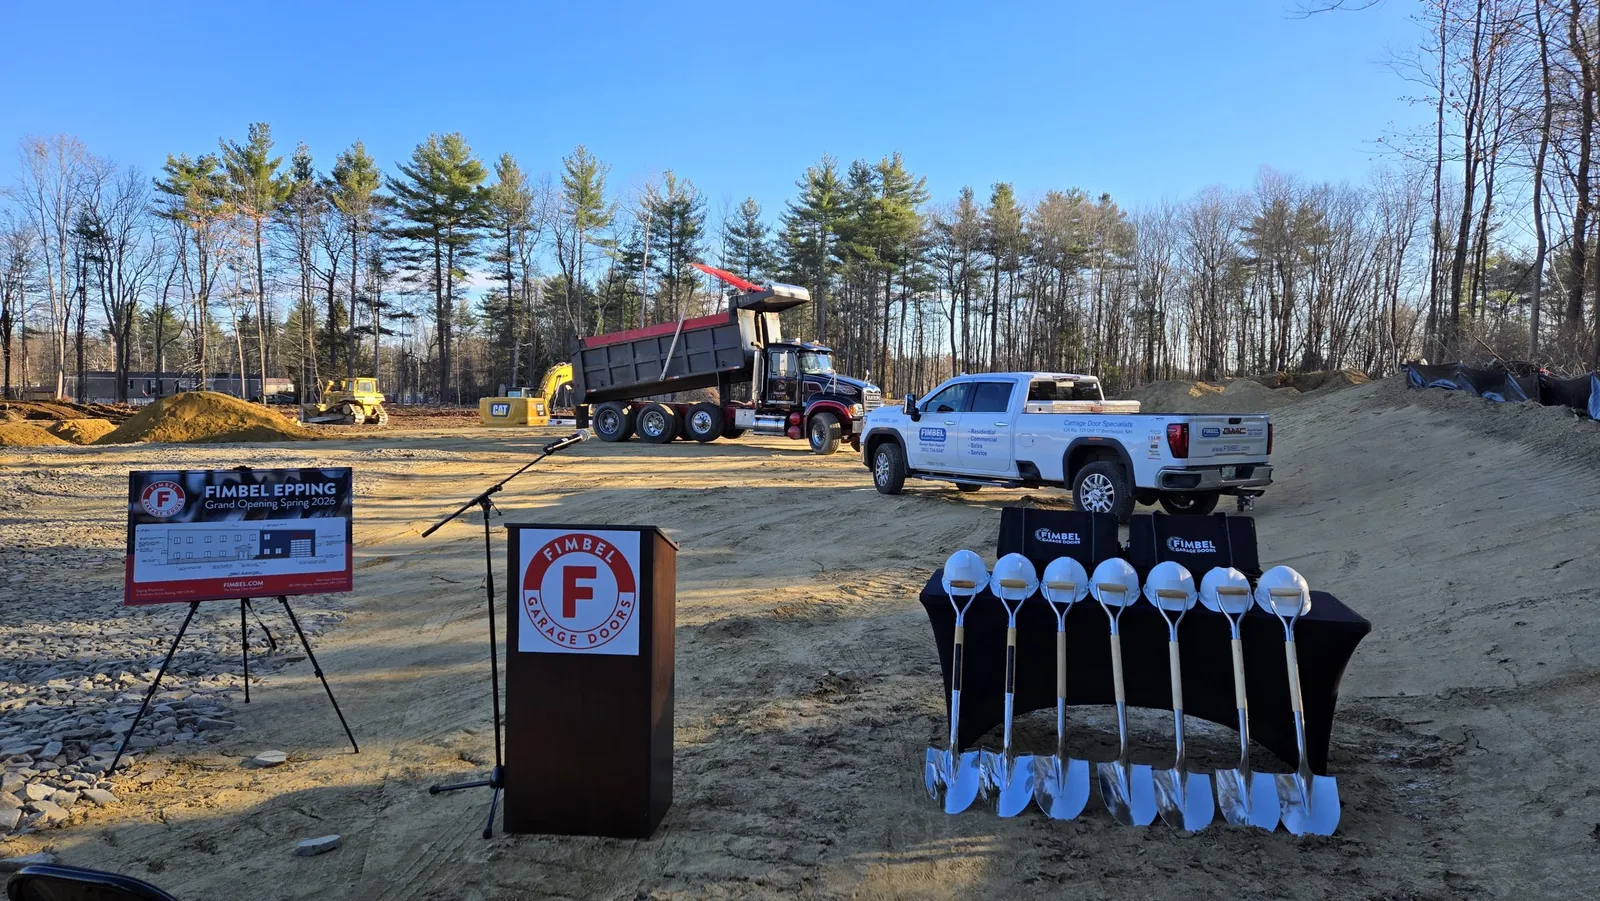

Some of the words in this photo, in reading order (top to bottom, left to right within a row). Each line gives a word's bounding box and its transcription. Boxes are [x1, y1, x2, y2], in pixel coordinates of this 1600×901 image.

[492, 403, 508, 416] CAT
[205, 484, 269, 498] FIMBEL
[274, 483, 336, 496] EPPING
[157, 491, 170, 507] F
[205, 499, 234, 509] Grand
[238, 498, 278, 510] Opening
[280, 498, 309, 510] Spring
[311, 497, 336, 506] 2026
[1041, 531, 1080, 540] FIMBEL
[542, 537, 616, 564] FIMBEL
[1174, 540, 1216, 549] FIMBEL
[562, 565, 597, 618] F
[528, 596, 577, 645] GARAGE
[588, 599, 631, 644] DOORS
